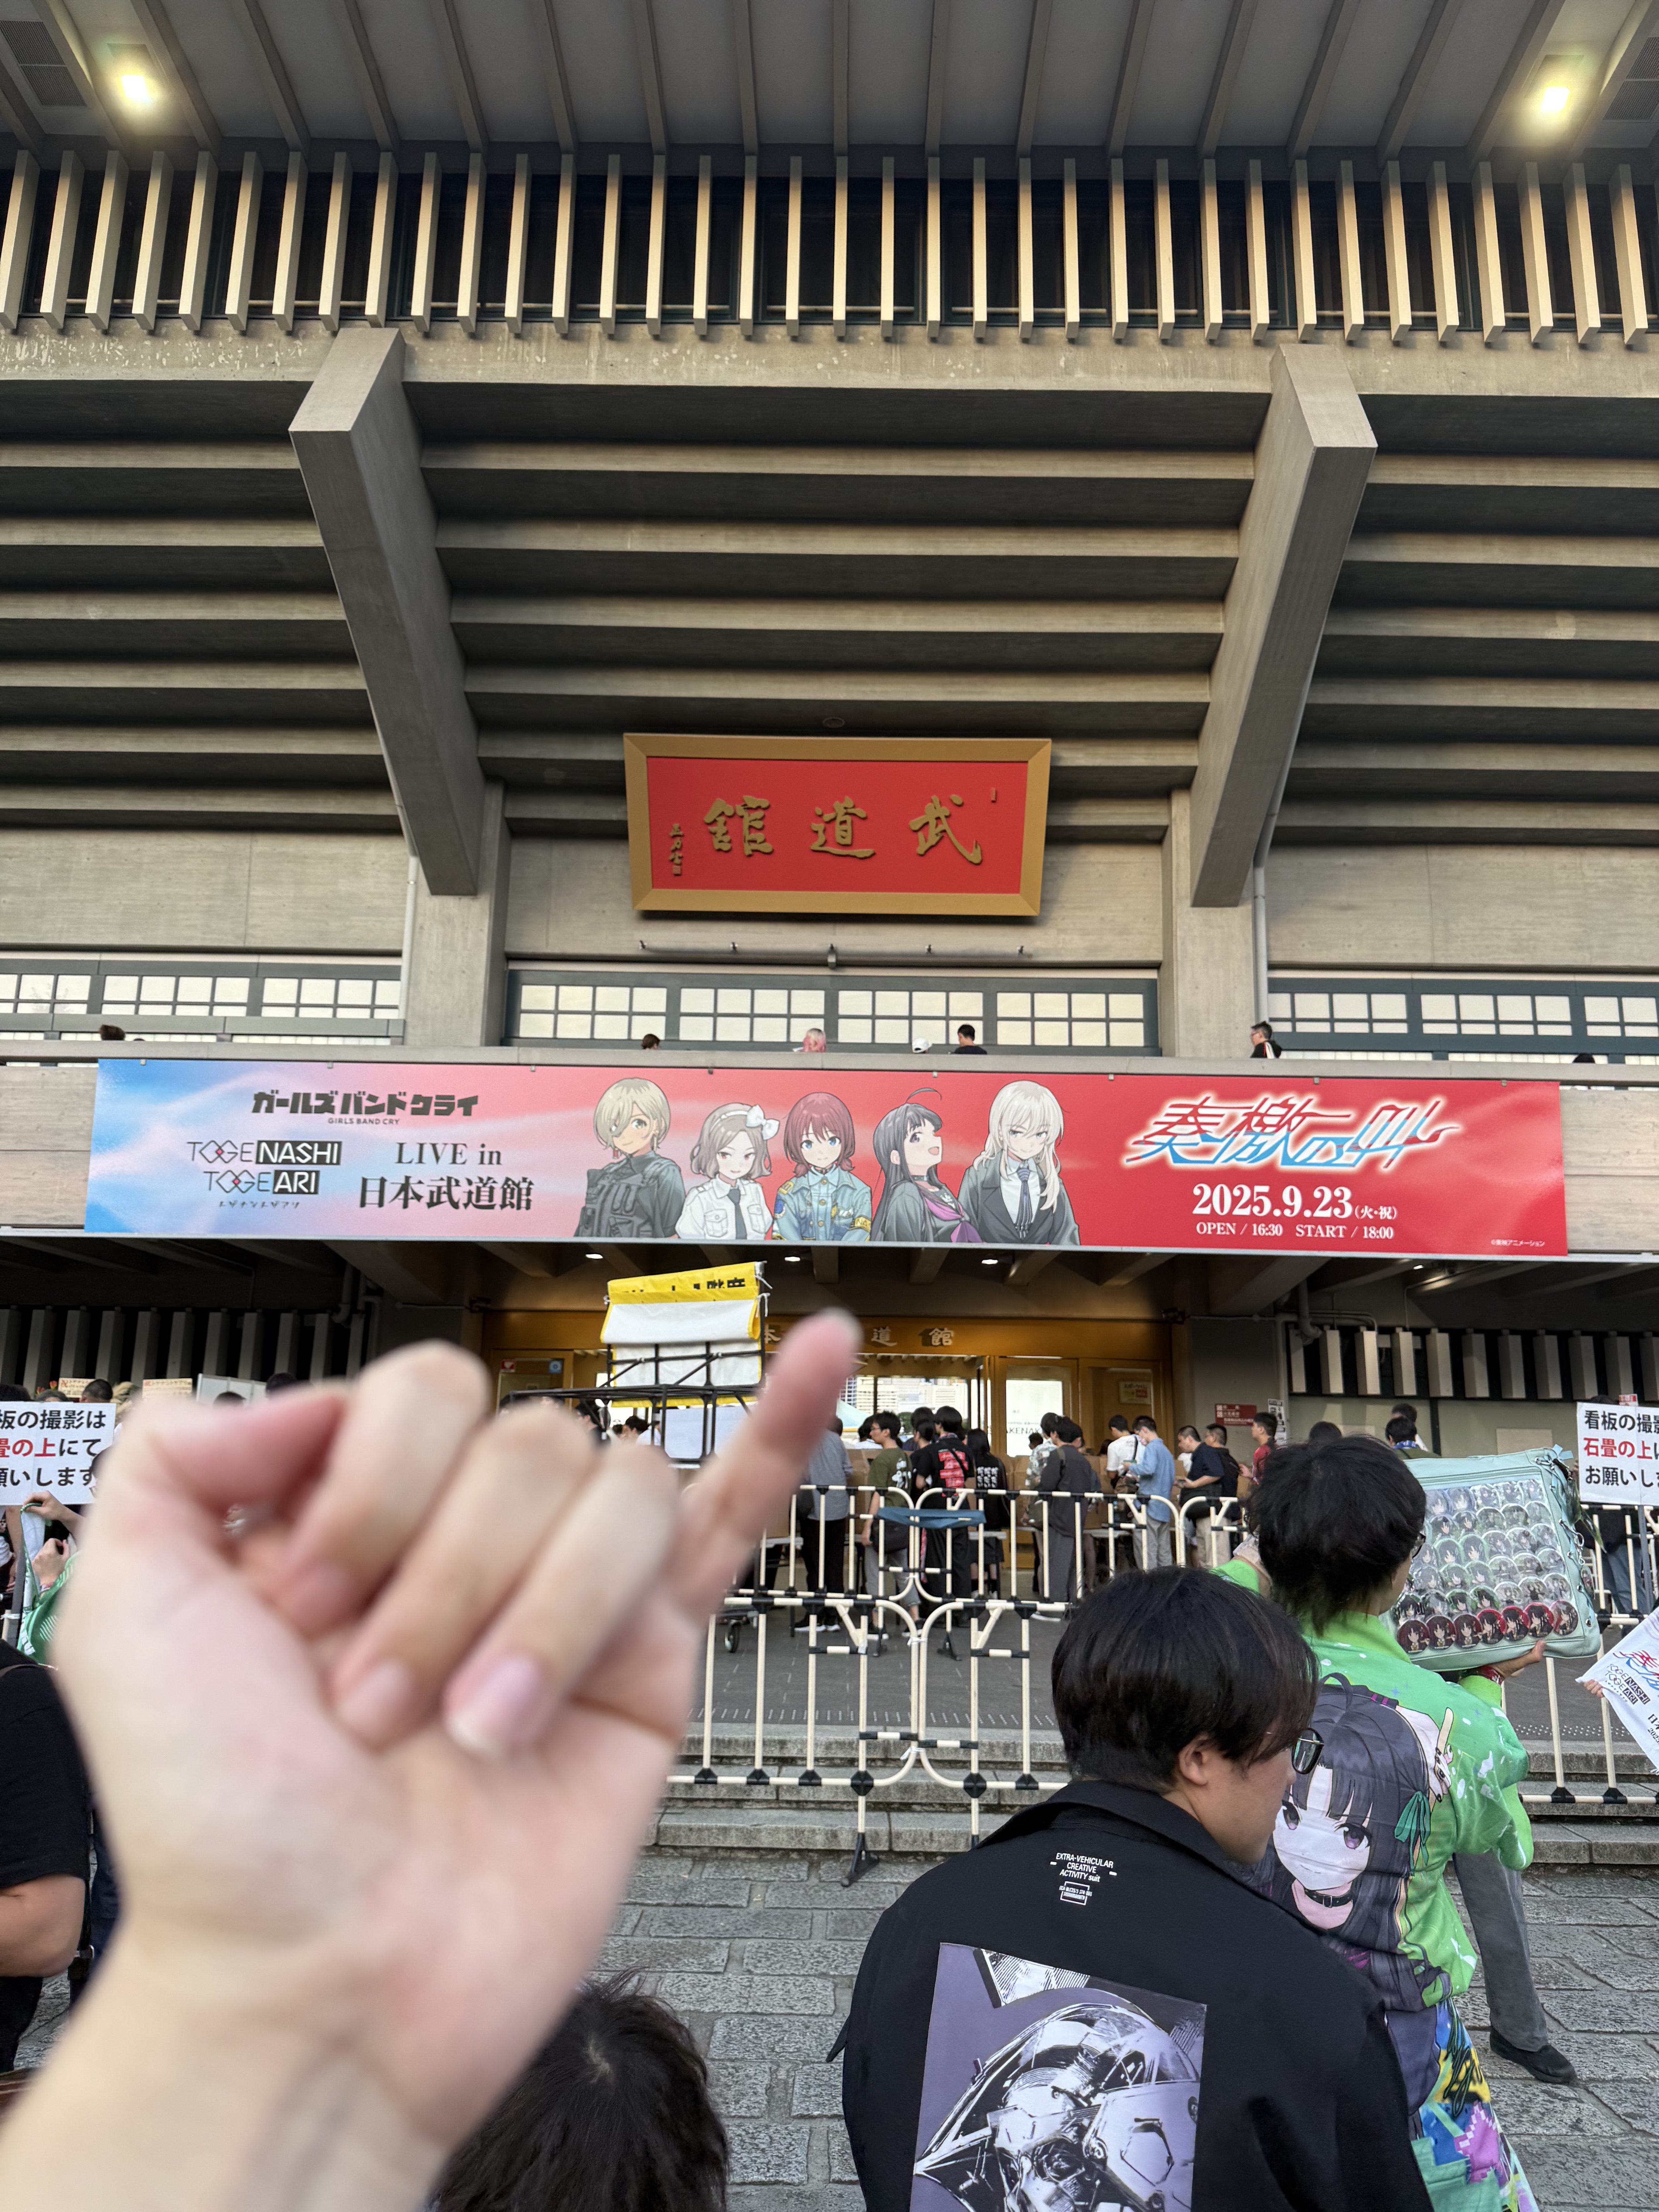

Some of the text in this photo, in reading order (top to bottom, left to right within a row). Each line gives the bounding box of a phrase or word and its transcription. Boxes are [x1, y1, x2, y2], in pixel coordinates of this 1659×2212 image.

[395, 1142, 502, 1165] LIVE in
[360, 1175, 534, 1210] 日本武道館
[1196, 1222, 1236, 1235] OPEN
[1252, 1223, 1283, 1236] 16:30
[1296, 1224, 1346, 1238] START
[1363, 1226, 1394, 1239] 18:00
[1585, 1465, 1659, 1488] お願いし
[1056, 1853, 1113, 1869] EXTRA-VEHICULAR
[1067, 1862, 1097, 1873] CREATIVE
[1060, 1869, 1088, 1879] ACTIVITY
